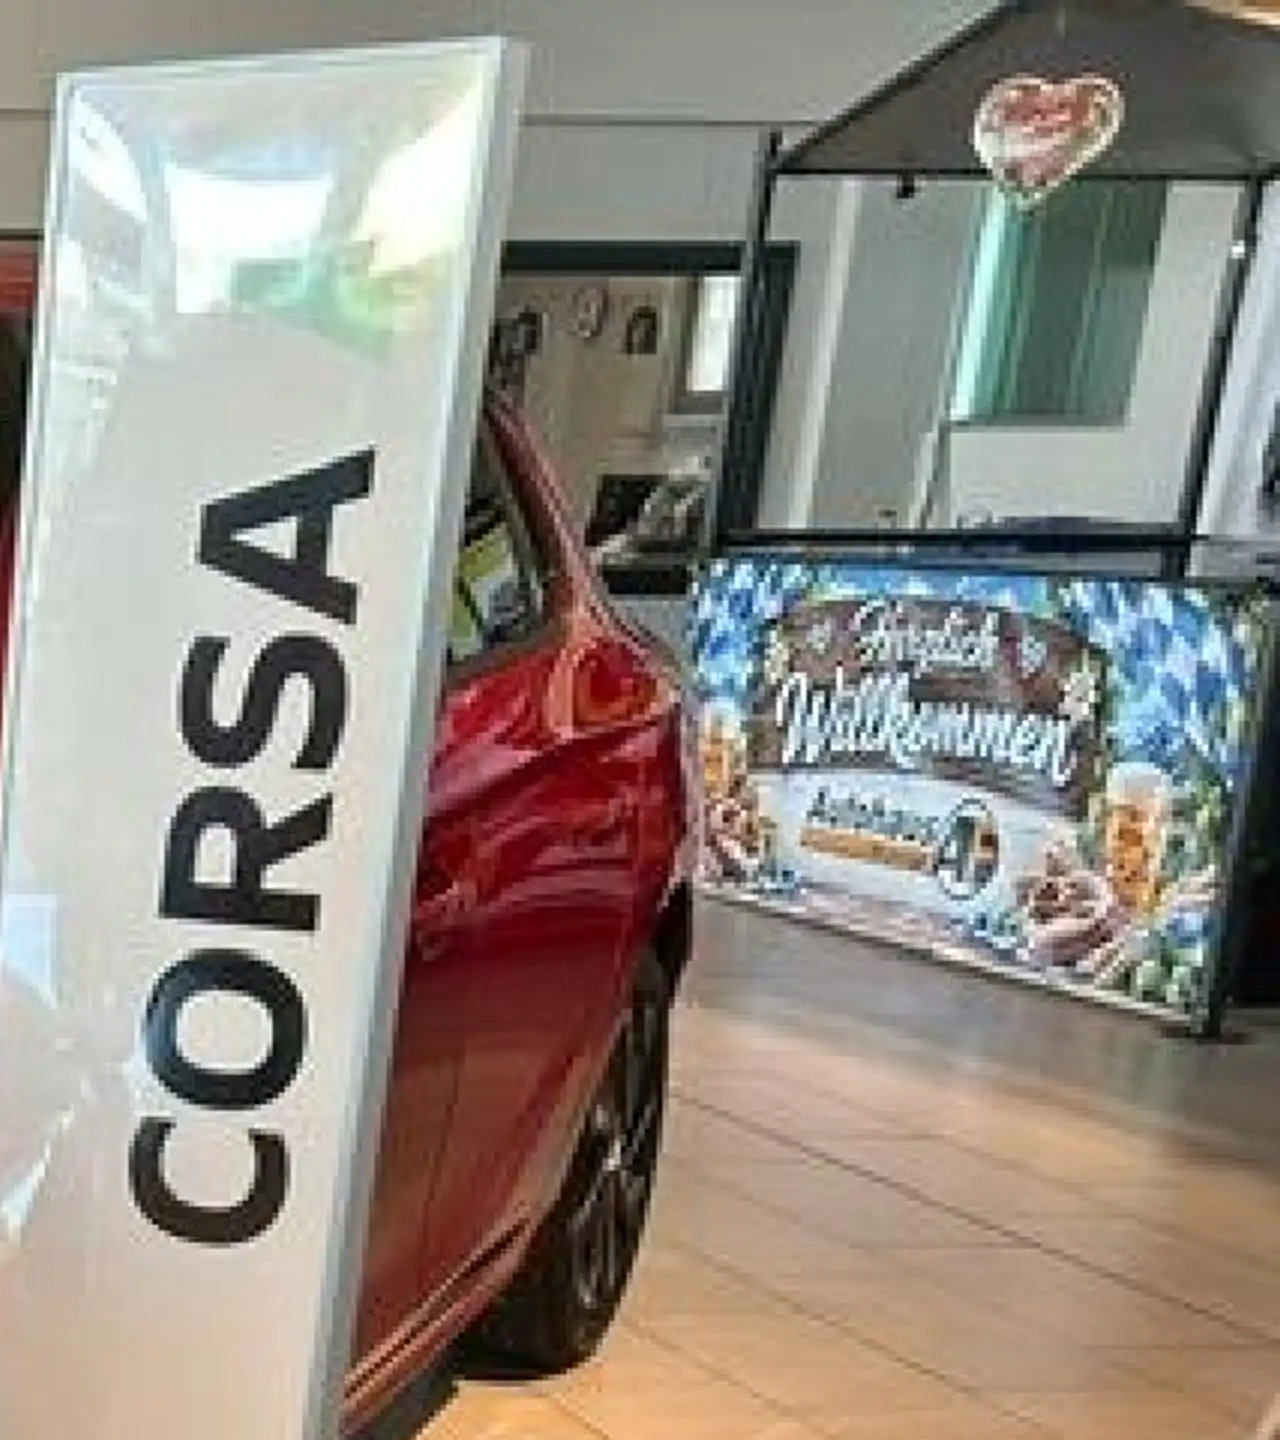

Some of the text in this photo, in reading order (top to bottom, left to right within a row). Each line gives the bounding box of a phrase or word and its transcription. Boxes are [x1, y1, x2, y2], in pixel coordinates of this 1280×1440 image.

[776, 664, 1074, 786] Willkommen
[128, 445, 375, 1246] CORSA
[806, 788, 940, 845] Autohaus
